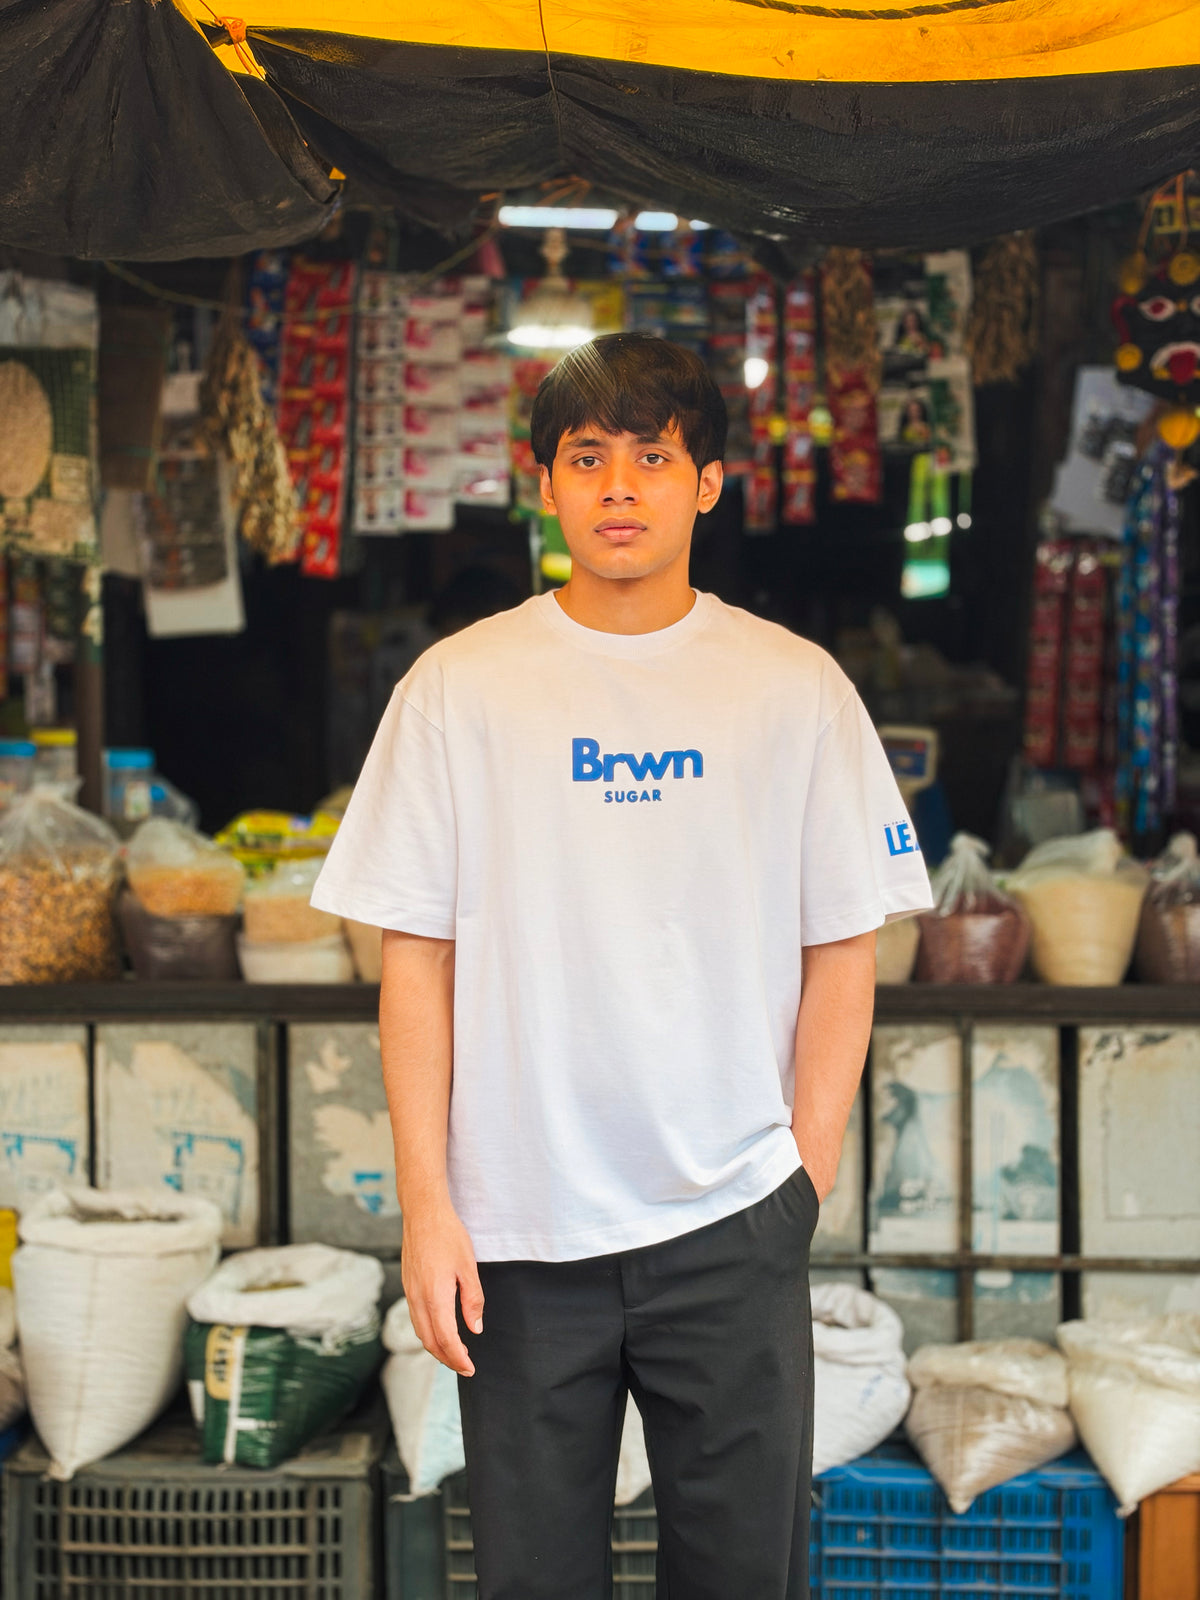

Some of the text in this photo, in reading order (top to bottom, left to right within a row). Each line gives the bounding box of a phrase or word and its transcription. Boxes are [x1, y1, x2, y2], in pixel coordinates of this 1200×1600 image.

[572, 738, 703, 782] Brwn
[604, 789, 662, 803] SUGAR
[884, 822, 920, 856] LE
